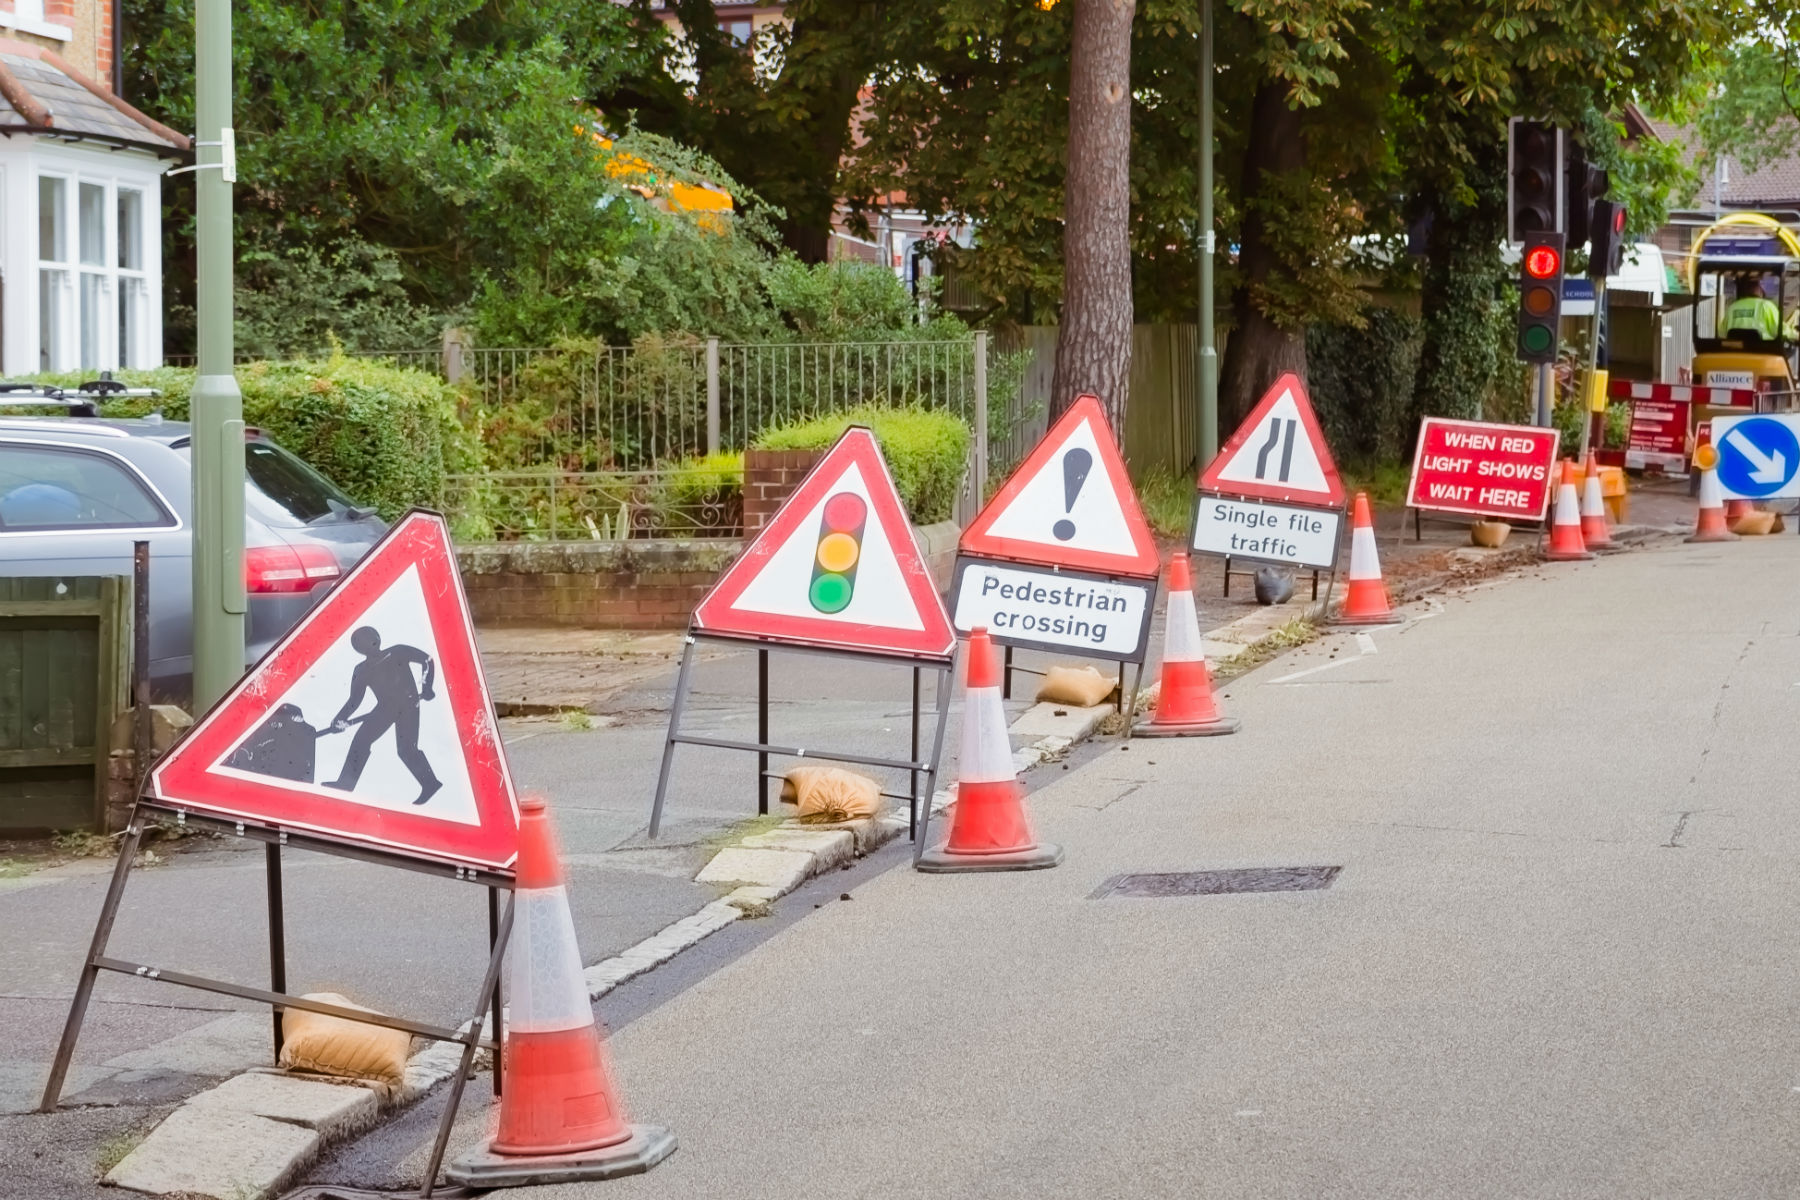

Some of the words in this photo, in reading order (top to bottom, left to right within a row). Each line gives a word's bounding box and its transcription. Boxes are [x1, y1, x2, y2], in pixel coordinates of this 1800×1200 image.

[1708, 373, 1753, 384] Alliance
[1444, 431, 1496, 451] WHEN
[1501, 437, 1535, 454] RED
[1423, 455, 1472, 474] LIGHT
[1477, 460, 1545, 481] SHOWS
[1429, 483, 1474, 501] WAIT
[1478, 488, 1531, 508] HERE
[1213, 504, 1278, 528] Single
[1288, 514, 1323, 534] file
[1231, 533, 1297, 557] traffic
[982, 575, 1127, 613] Pedestrian
[993, 610, 1107, 643] crossing
